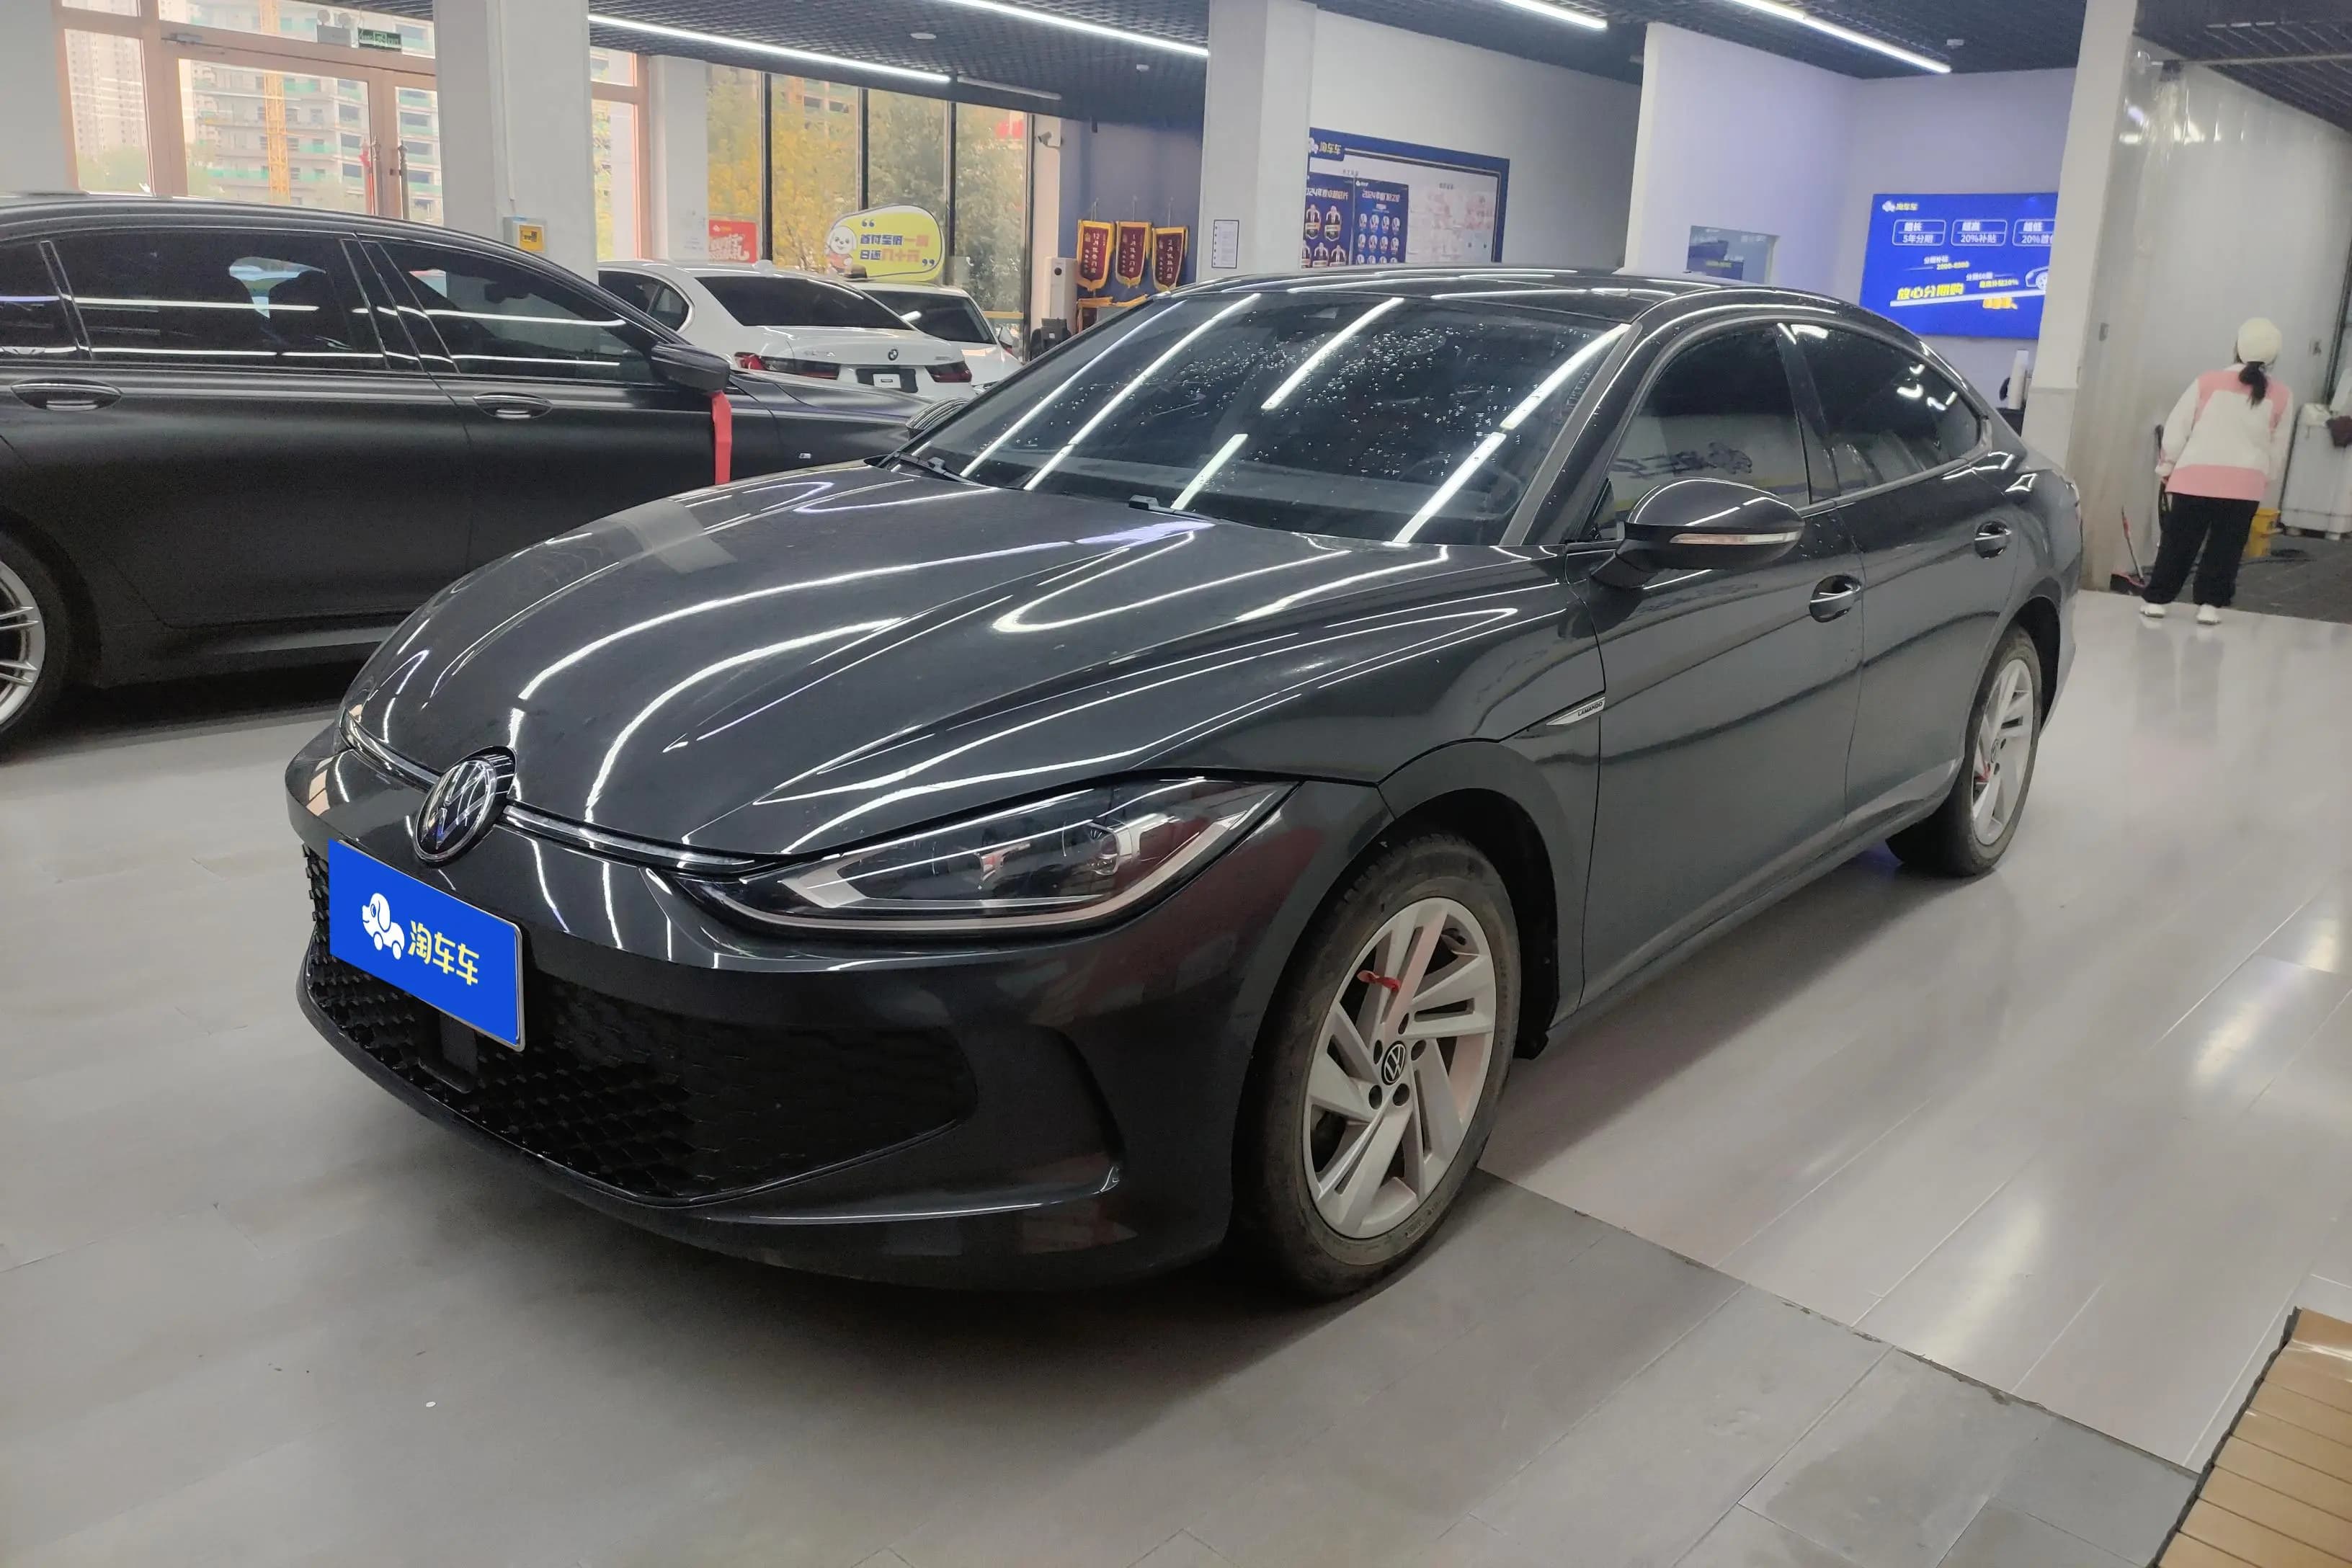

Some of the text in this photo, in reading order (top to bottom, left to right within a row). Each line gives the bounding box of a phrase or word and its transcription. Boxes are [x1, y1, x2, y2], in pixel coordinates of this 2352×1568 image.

[1902, 234, 1934, 244] 5年分期
[1961, 234, 1996, 244] 20%补贴
[1897, 282, 1964, 300] 放心分期购
[1577, 700, 1603, 717] LAMANDO
